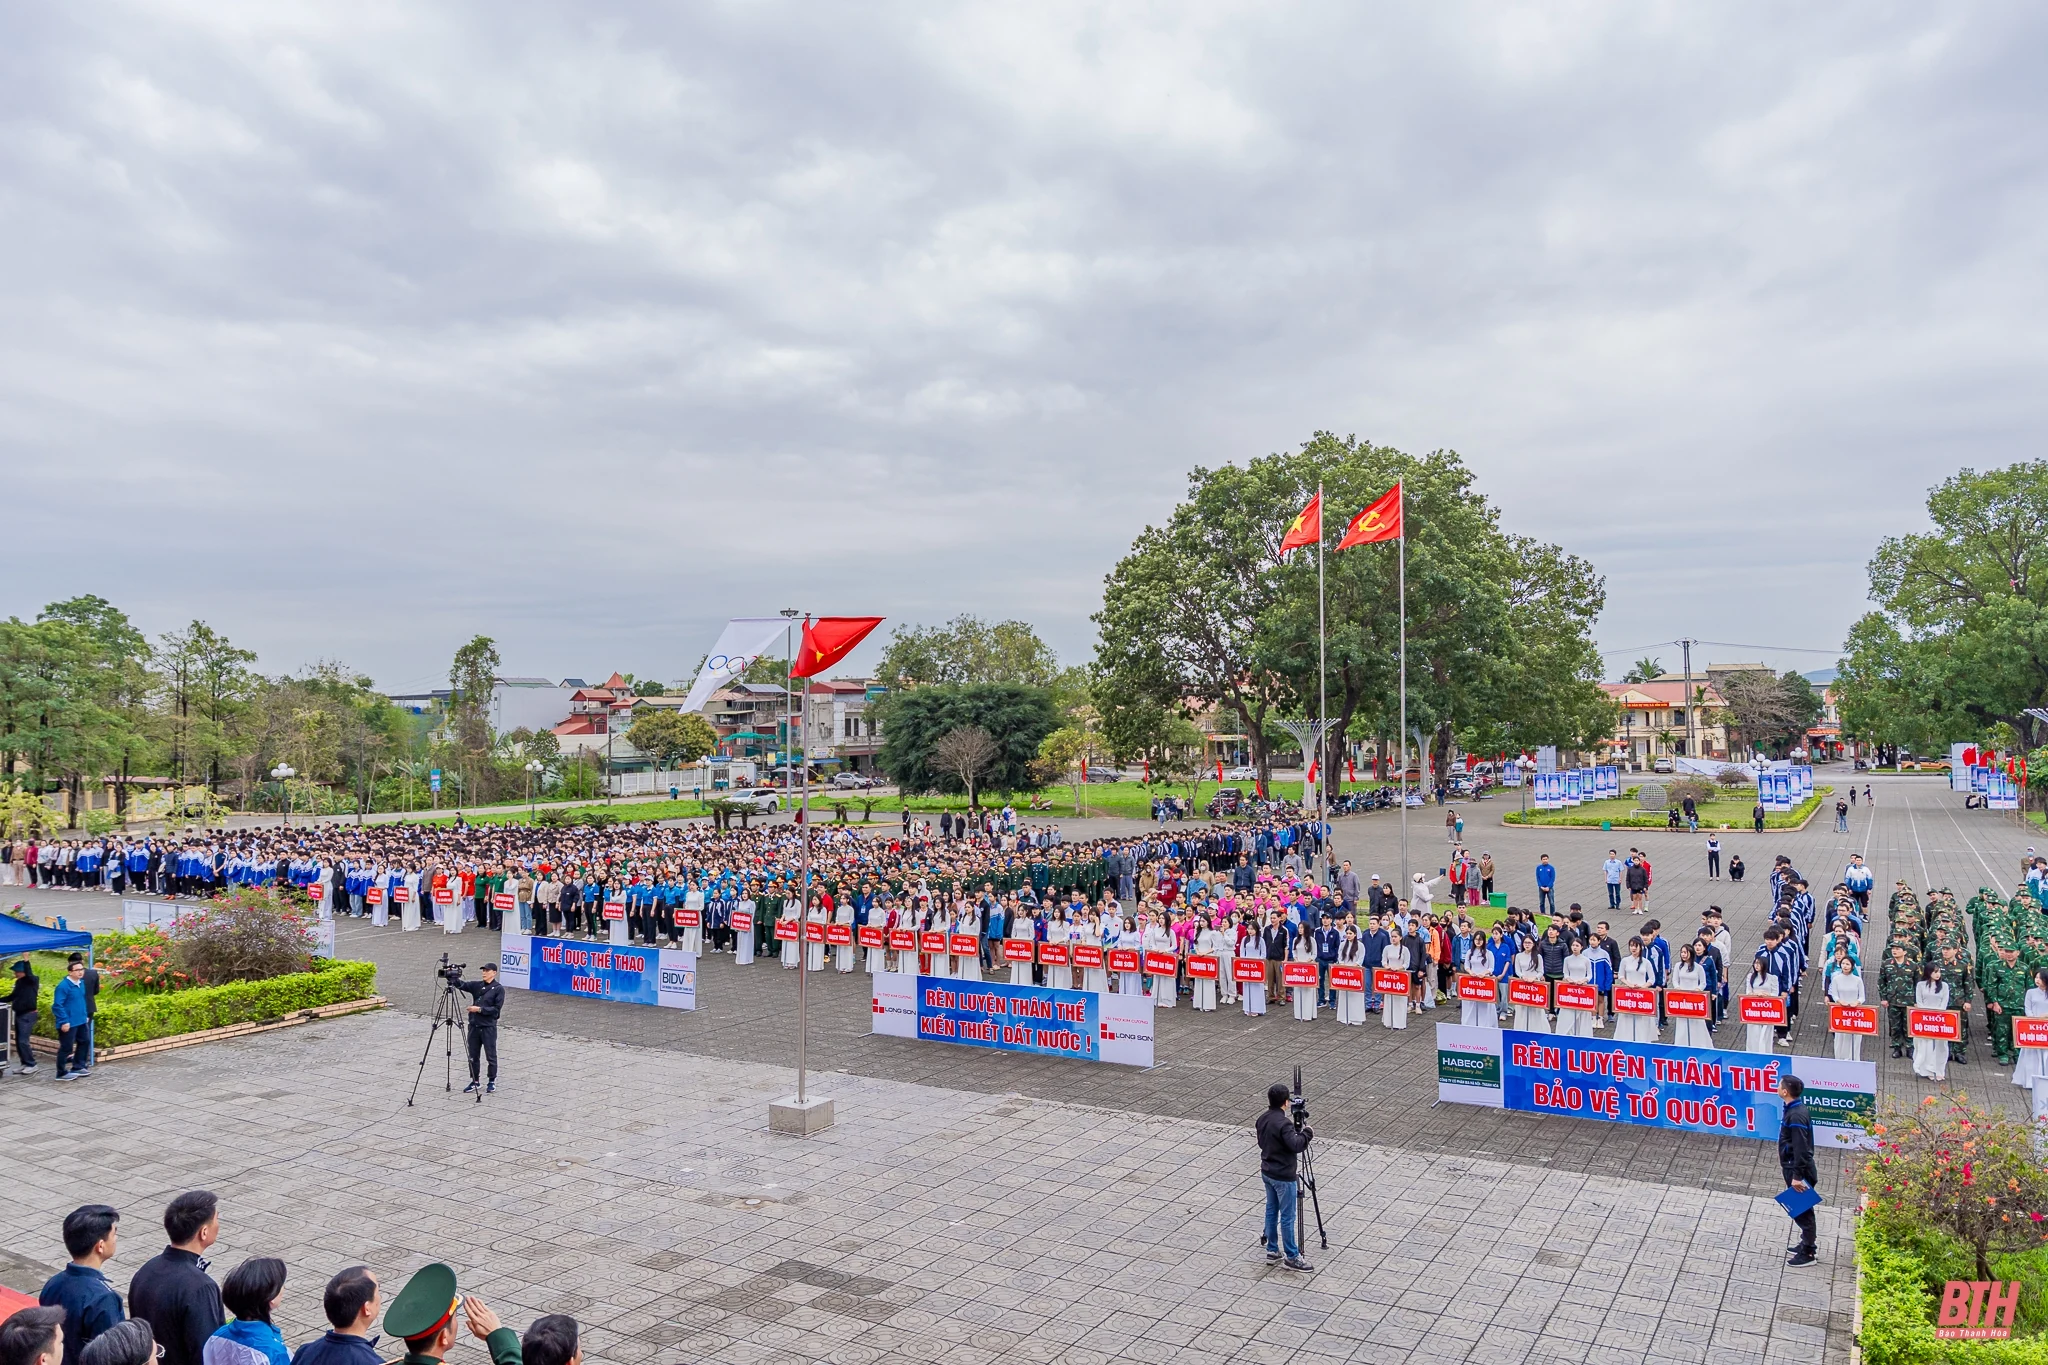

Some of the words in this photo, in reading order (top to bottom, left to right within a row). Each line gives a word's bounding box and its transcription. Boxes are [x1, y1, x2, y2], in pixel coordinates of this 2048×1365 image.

[502, 954, 521, 966] BIDV
[565, 949, 587, 968] DỤC
[614, 954, 645, 973] THAO
[572, 972, 602, 994] KHỎE
[662, 972, 685, 984] BIDV
[1512, 991, 1530, 1001] NGỌC
[926, 987, 956, 1009] RÈN
[959, 992, 1006, 1017] LUYỆN
[1010, 996, 1052, 1019] THÂN
[1056, 998, 1086, 1022] THỂ
[1617, 999, 1636, 1009] TRIỆU
[1638, 1001, 1652, 1009] SƠN
[1669, 1000, 1679, 1009] CAO
[1752, 1000, 1772, 1008] KHỐI
[1842, 1009, 1864, 1018] KHỐI
[1922, 1014, 1946, 1022] KHỐI
[1842, 1018, 1851, 1027] TẾ
[1854, 1019, 1872, 1028] TỈNH
[1914, 1023, 1922, 1032] BỘ
[921, 1013, 955, 1037] KIẾN
[958, 1018, 999, 1041] THIẾT
[1003, 1022, 1033, 1046] ĐẤT
[1037, 1030, 1081, 1051] NƯỚC
[1442, 1057, 1484, 1069] HABECO
[1513, 1040, 1560, 1071] RÈN
[1567, 1049, 1645, 1082] LUYỆN
[1652, 1056, 1722, 1088] THÂN
[1728, 1060, 1780, 1094] THỂ
[1534, 1078, 1582, 1111] BẢO
[1589, 1086, 1620, 1119] VỆ
[1626, 1088, 1658, 1119] TỔ
[1666, 1096, 1737, 1129] QUỐC
[1746, 1107, 1755, 1131] !
[1803, 1096, 1855, 1108] HABECO
